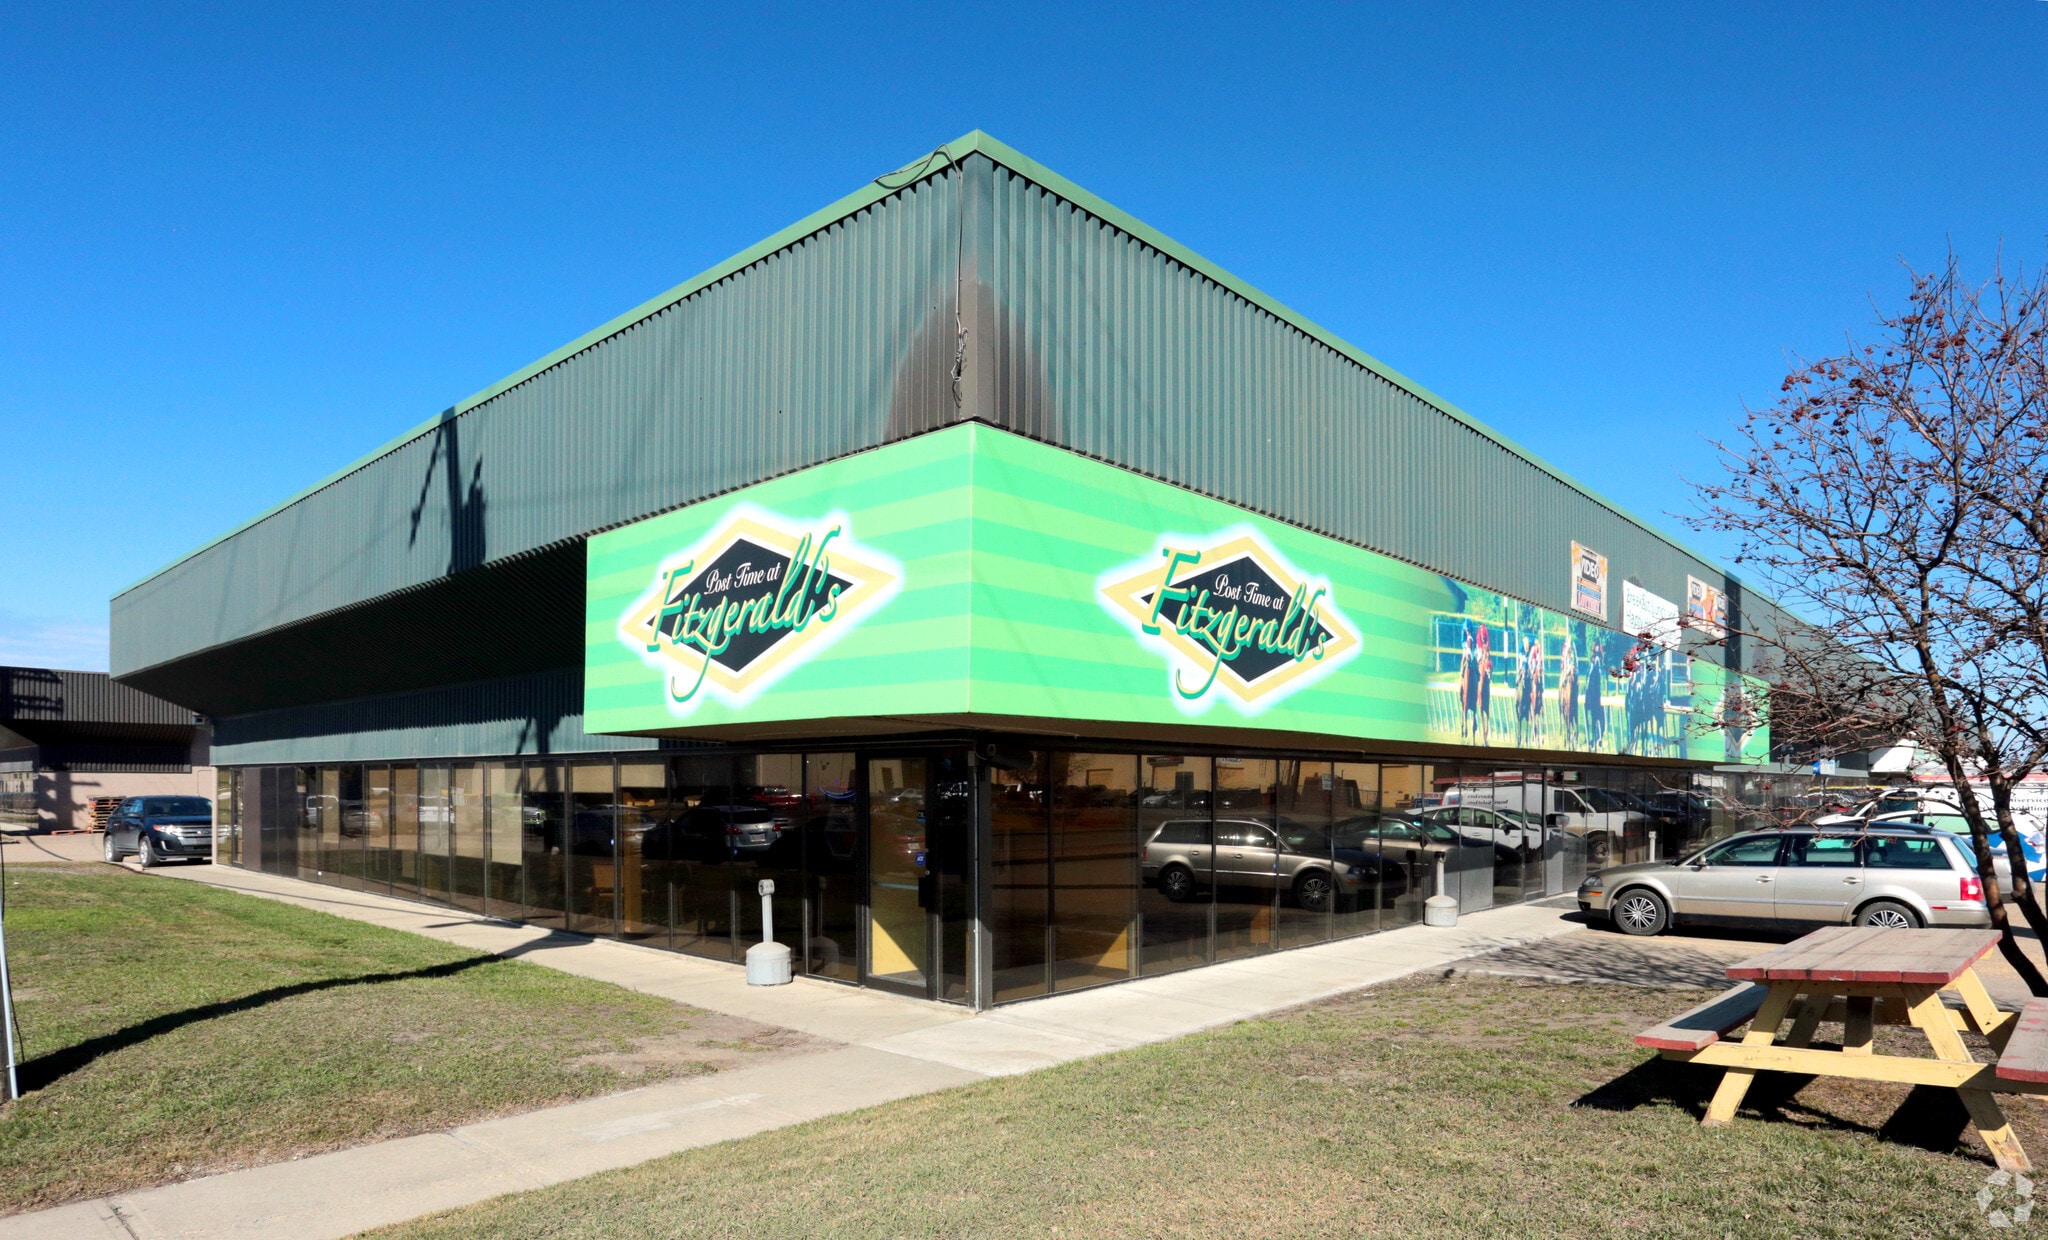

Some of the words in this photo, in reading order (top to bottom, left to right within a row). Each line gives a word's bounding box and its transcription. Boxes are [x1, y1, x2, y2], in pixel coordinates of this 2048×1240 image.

[704, 570, 731, 595] Post
[734, 562, 766, 588] Time
[767, 562, 781, 582] at
[1581, 557, 1599, 579] VIDEO
[1213, 574, 1241, 601] Post
[1244, 582, 1272, 608] Time
[1272, 594, 1285, 611] at
[647, 525, 841, 702] Fitzgerald's
[1142, 546, 1326, 700] Fitzgerald's
